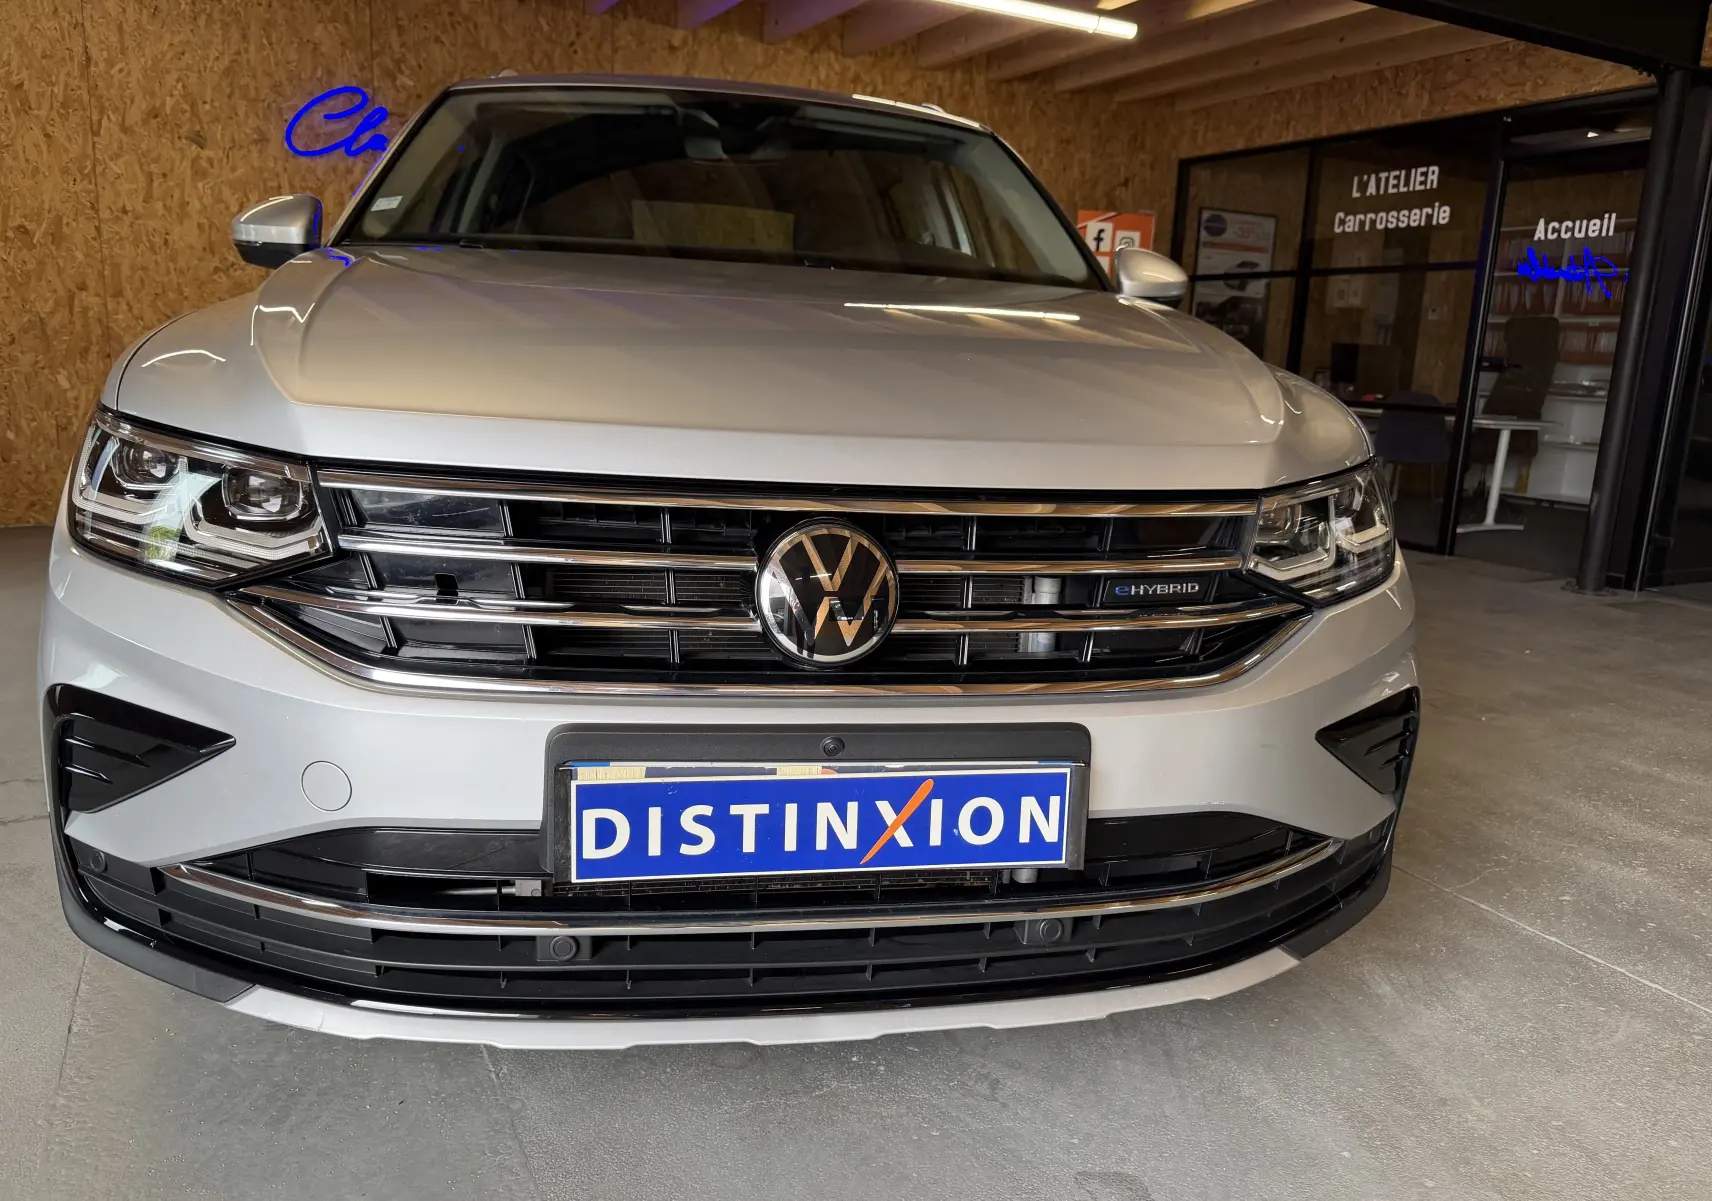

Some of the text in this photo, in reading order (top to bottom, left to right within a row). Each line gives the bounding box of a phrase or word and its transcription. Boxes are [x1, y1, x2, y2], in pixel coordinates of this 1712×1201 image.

[1352, 165, 1439, 198] L'ATELIER
[1334, 202, 1451, 233] Carrosserie
[1533, 213, 1617, 241] Accueil
[1115, 582, 1200, 596] eHYBRID
[582, 779, 1061, 865] DISTINXION
